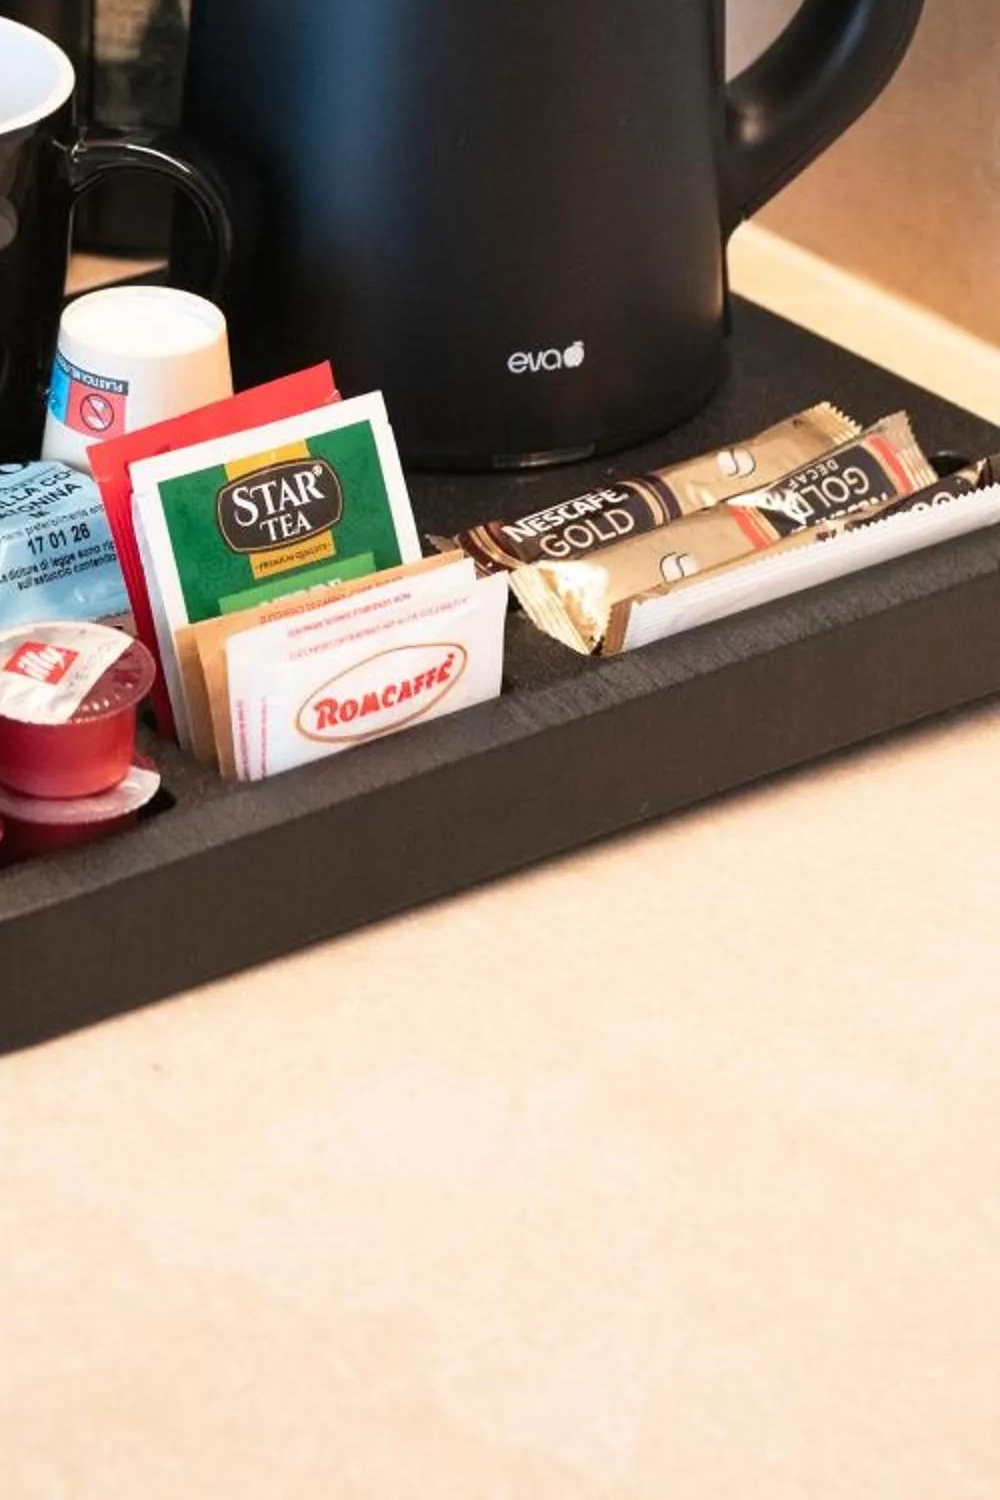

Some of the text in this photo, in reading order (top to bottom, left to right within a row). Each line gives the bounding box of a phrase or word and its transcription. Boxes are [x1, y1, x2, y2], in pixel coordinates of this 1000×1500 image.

[507, 348, 562, 373] eva
[231, 470, 326, 528] STAR
[259, 510, 313, 541] TEA
[539, 509, 635, 558] GOLD
[27, 535, 44, 556] 17
[48, 528, 67, 549] 01
